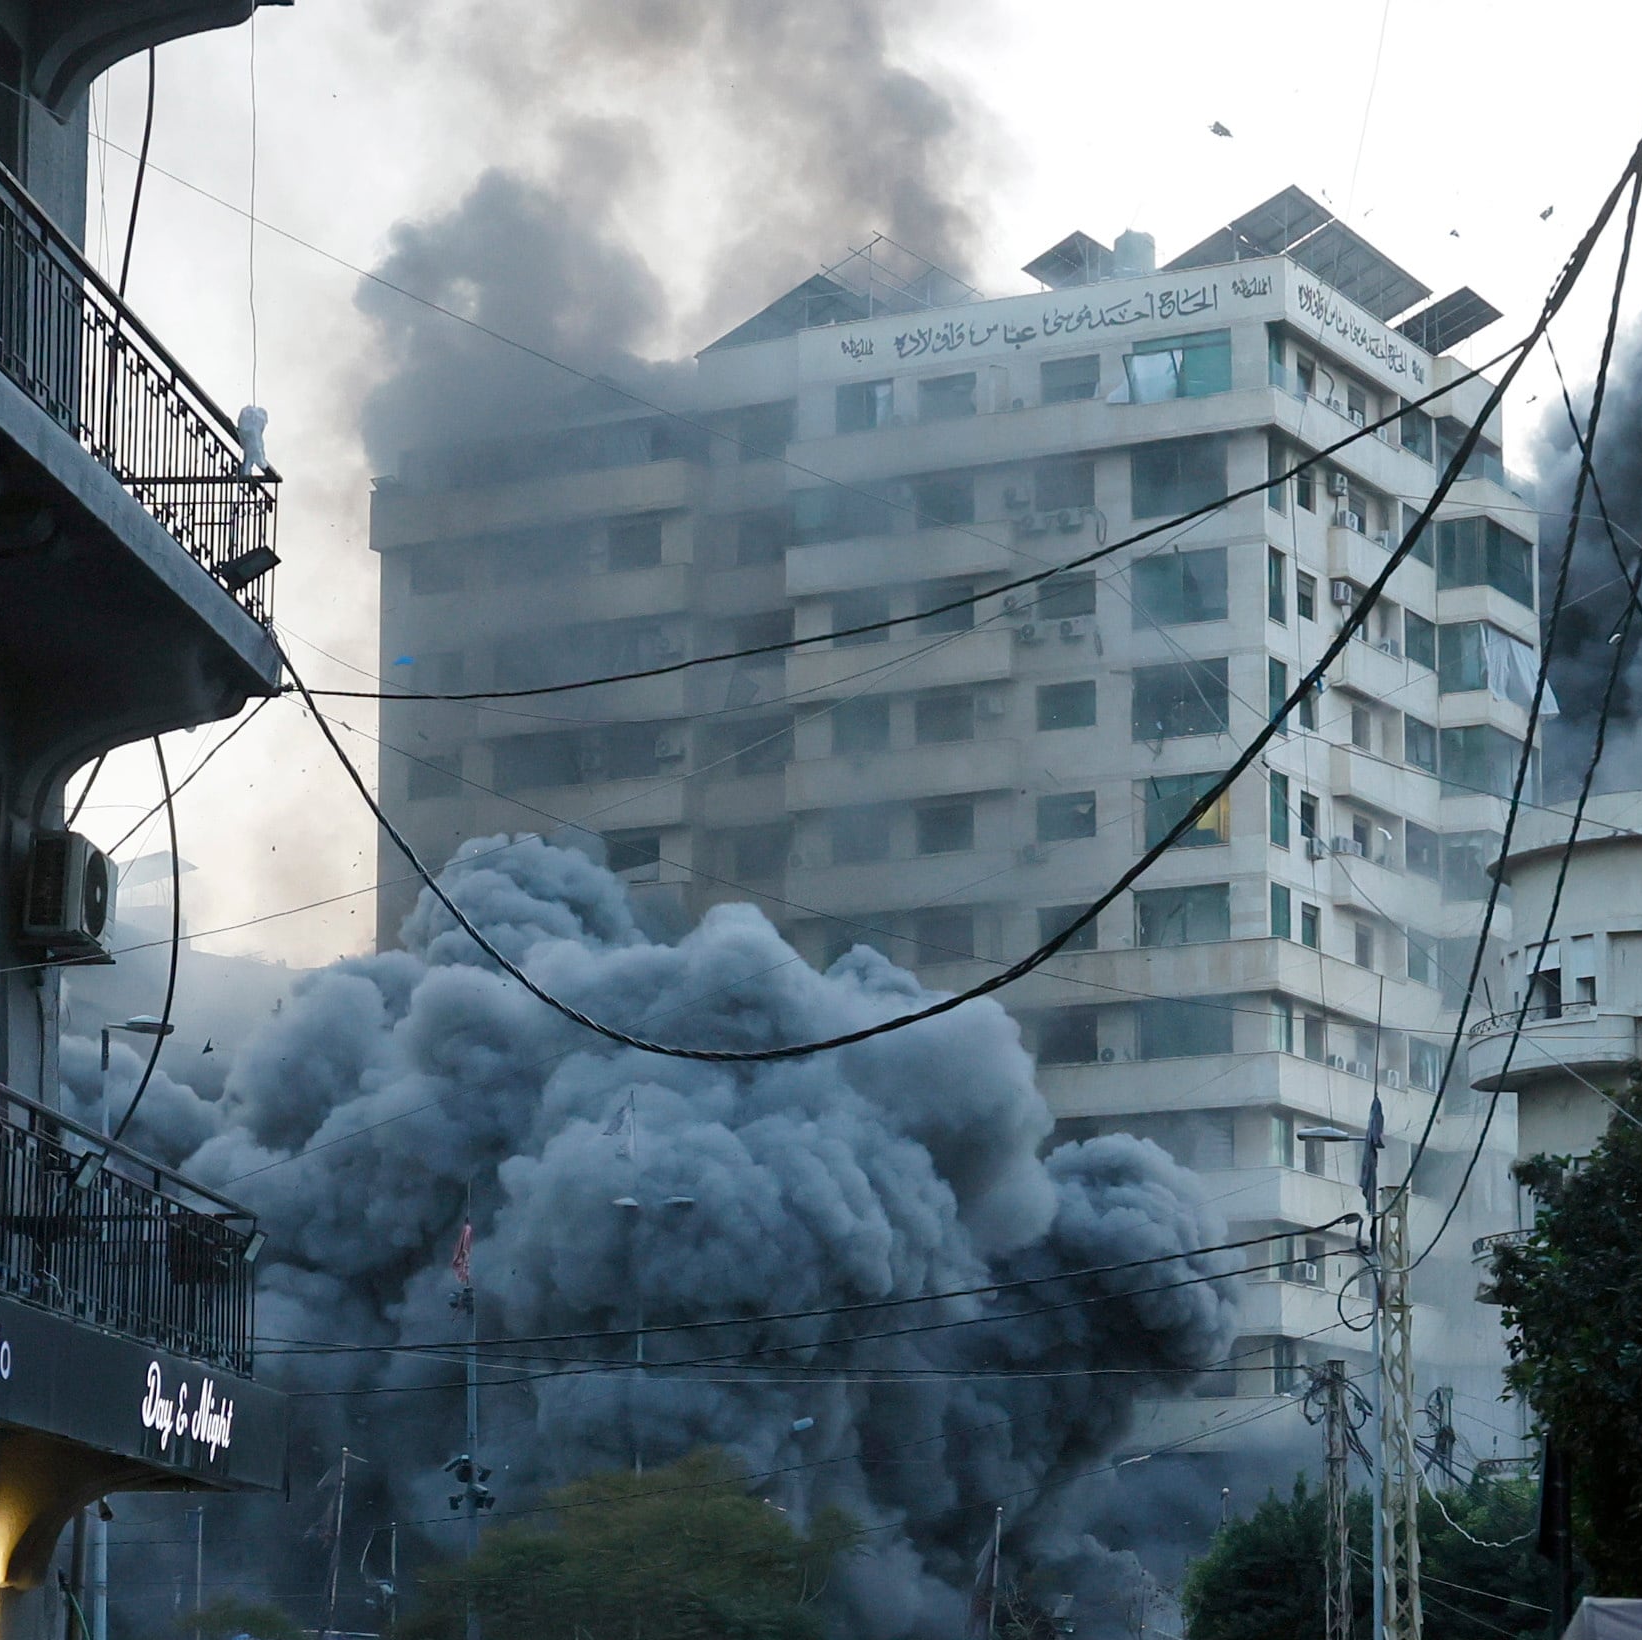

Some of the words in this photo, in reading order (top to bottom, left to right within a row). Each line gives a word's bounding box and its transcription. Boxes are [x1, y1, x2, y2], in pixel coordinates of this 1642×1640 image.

[141, 1360, 174, 1452] Day
[175, 1381, 189, 1437] &
[191, 1377, 234, 1464] Night
